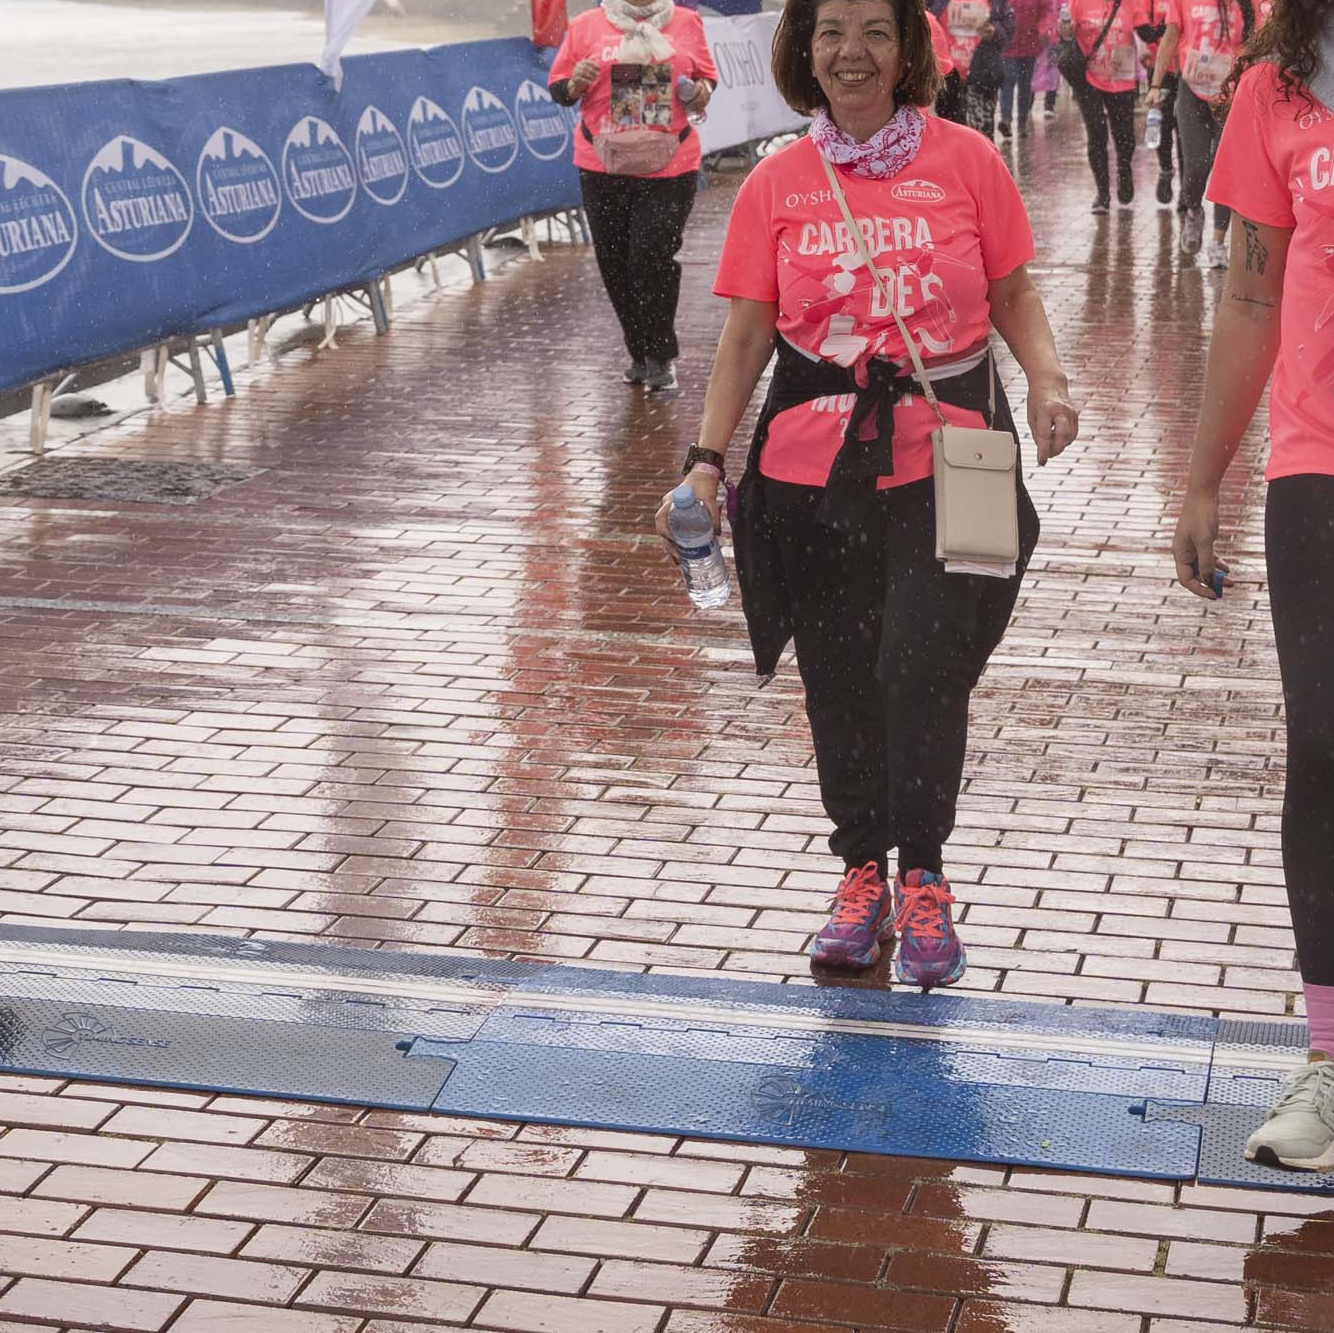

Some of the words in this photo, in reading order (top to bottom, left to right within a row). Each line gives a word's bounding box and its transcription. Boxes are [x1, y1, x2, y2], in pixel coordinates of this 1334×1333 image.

[94, 187, 188, 235] ASTURIANA
[206, 171, 277, 216] ASTURIANA
[897, 187, 941, 199] ASTURIANA
[798, 217, 935, 255] CARRERA
[870, 264, 916, 317] DE
